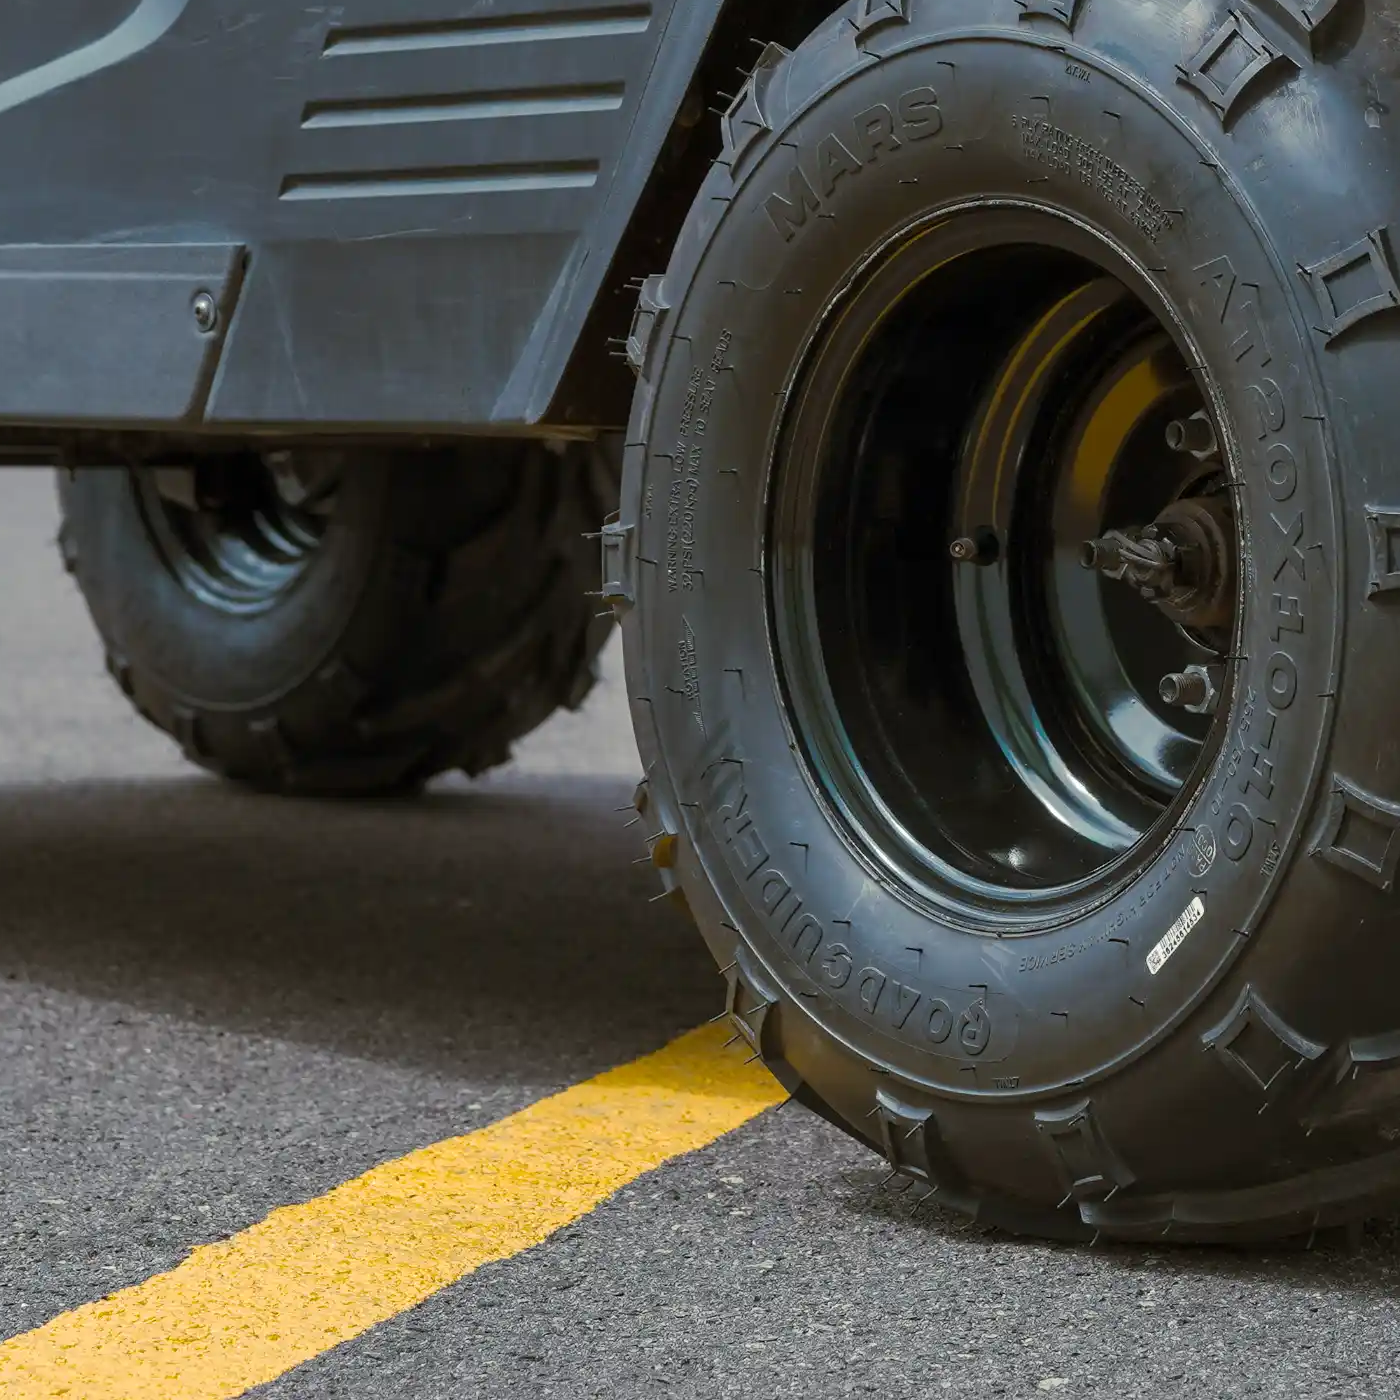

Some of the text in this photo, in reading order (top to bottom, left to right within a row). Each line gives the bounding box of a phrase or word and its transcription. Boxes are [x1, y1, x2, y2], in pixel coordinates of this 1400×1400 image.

[1021, 116, 1039, 132] PLY
[1042, 122, 1074, 147] RATING
[761, 84, 944, 244] MARS
[1047, 139, 1070, 159] LOAD
[1117, 184, 1130, 199] AT
[1048, 155, 1071, 176] LOAD
[1115, 200, 1129, 214] AT
[709, 327, 734, 375] BEADS
[680, 364, 705, 438] PRESSURE
[699, 376, 718, 417] SEAT
[694, 417, 709, 438] TO
[673, 439, 689, 475] LOW
[687, 443, 704, 477] MAX
[1162, 843, 1187, 882] NOT
[1138, 876, 1163, 908] FOR
[715, 792, 992, 1057] ROADGUIDER
[1017, 941, 1078, 974] SERVICE
